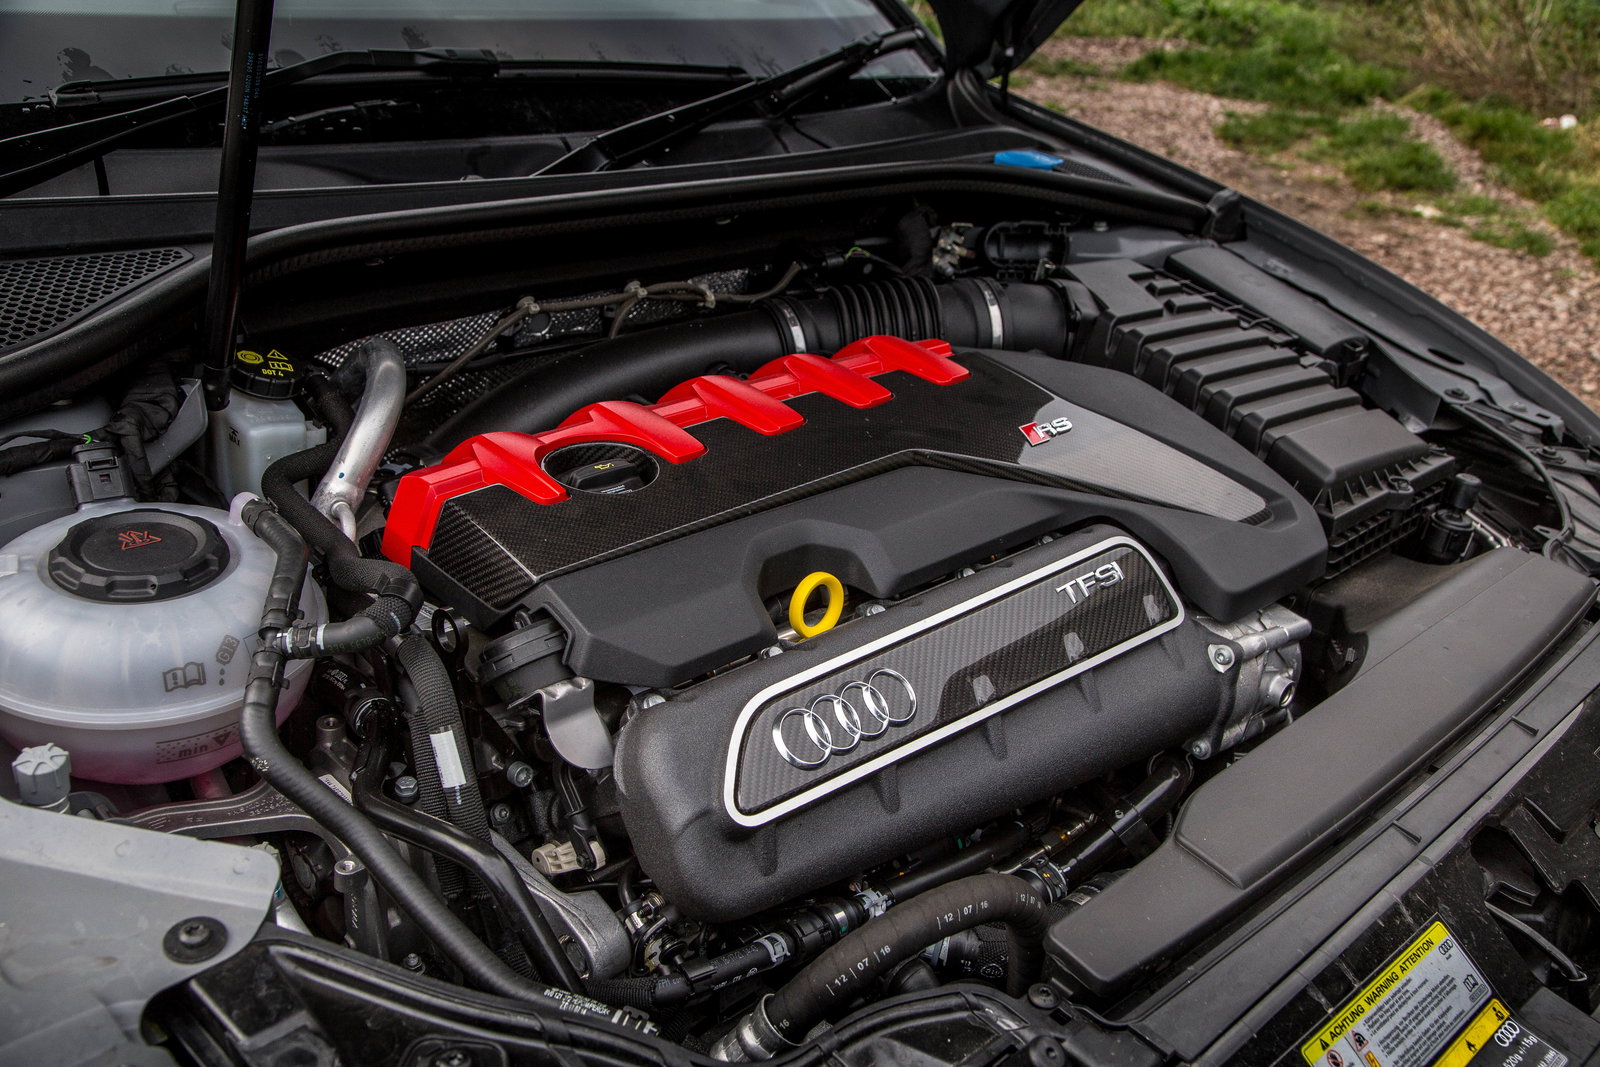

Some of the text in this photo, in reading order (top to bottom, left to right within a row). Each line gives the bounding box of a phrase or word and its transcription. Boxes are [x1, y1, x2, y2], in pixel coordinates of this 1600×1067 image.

[261, 368, 276, 377] DOT
[1030, 416, 1073, 440] RS
[1055, 561, 1125, 604] TFSI
[218, 636, 238, 664] G13
[178, 742, 208, 758] min
[944, 900, 989, 923] 12 07 16
[835, 944, 891, 987] 12 07 16
[1329, 1004, 1366, 1042] ACHTUNG
[1363, 971, 1400, 1006] WARNING
[1398, 937, 1435, 975] ATTENTION
[778, 1018, 790, 1029] 16
